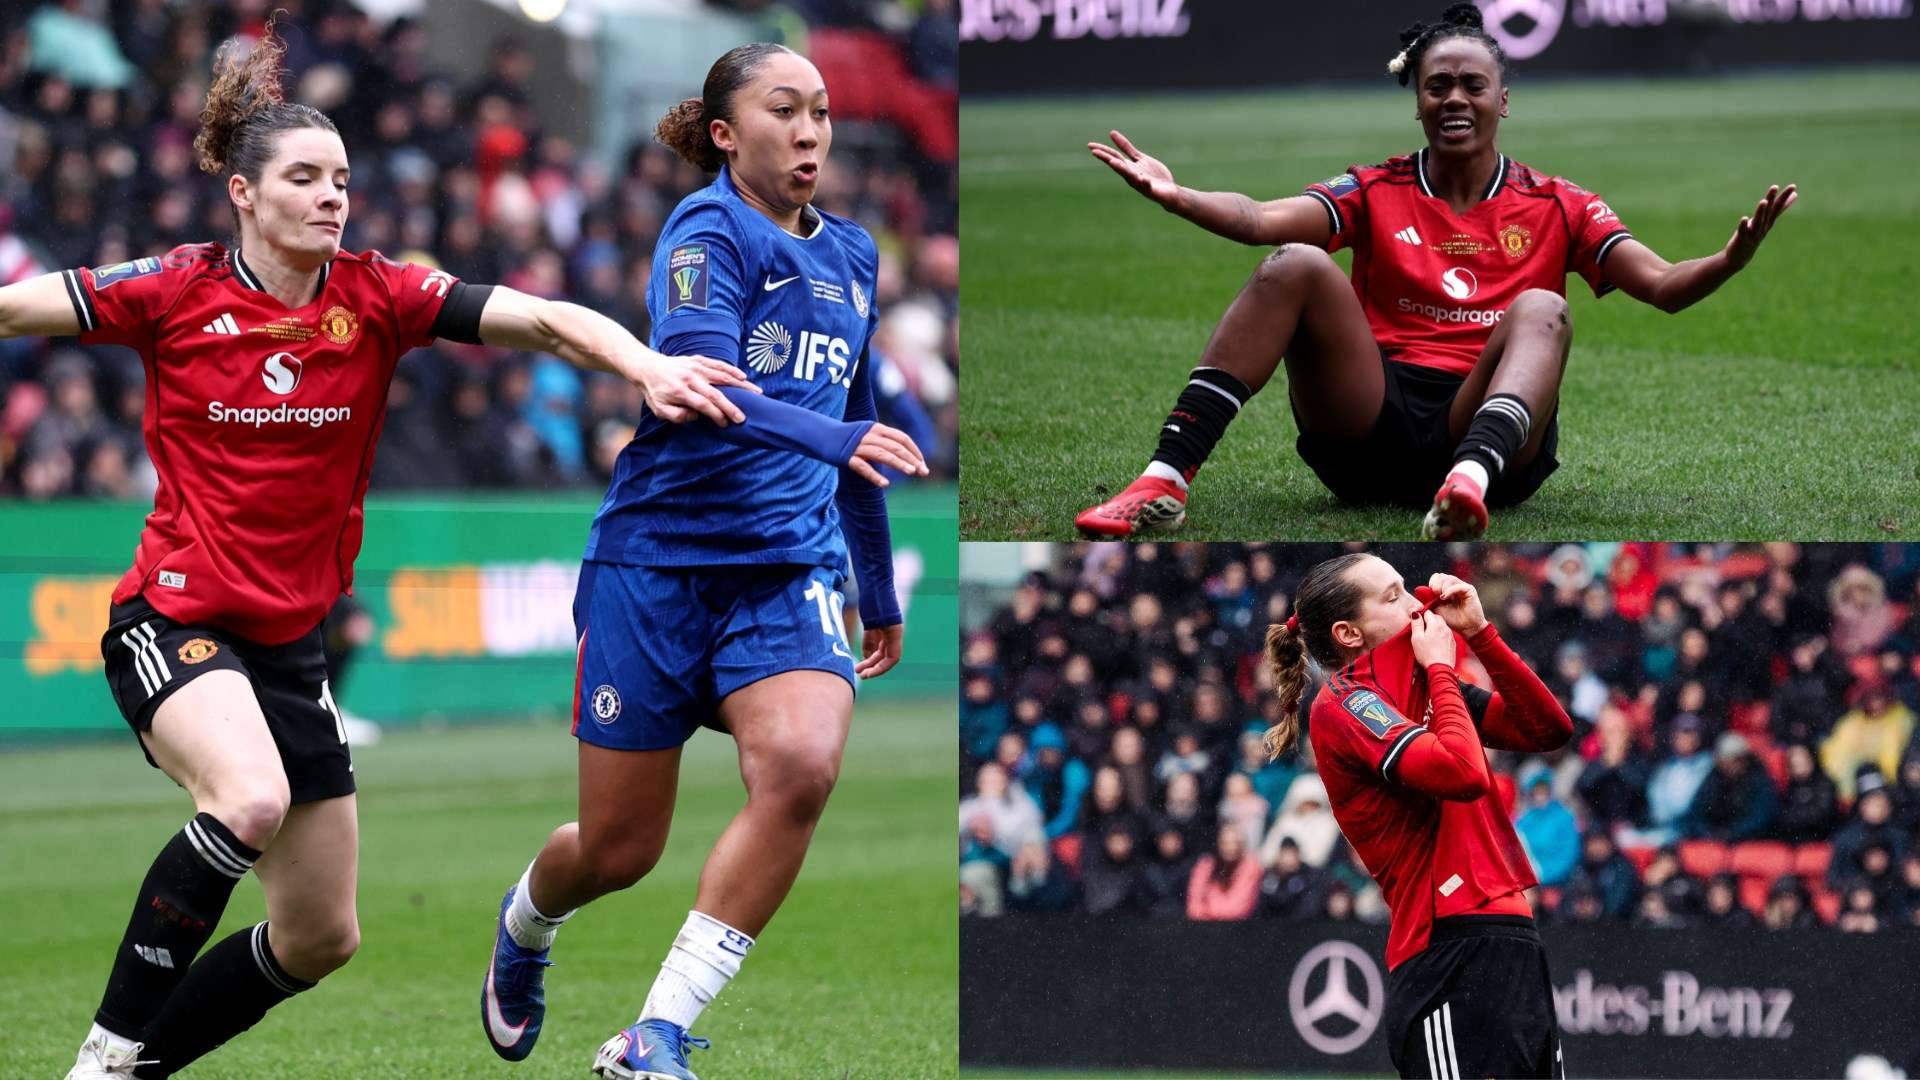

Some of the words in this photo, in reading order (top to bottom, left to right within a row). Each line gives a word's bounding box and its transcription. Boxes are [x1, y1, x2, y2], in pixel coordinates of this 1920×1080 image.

[671, 253, 705, 264] WOMEN'S
[207, 401, 351, 428] Snapdragon
[803, 579, 850, 651] 10
[1552, 968, 1795, 1038] des-Benz
